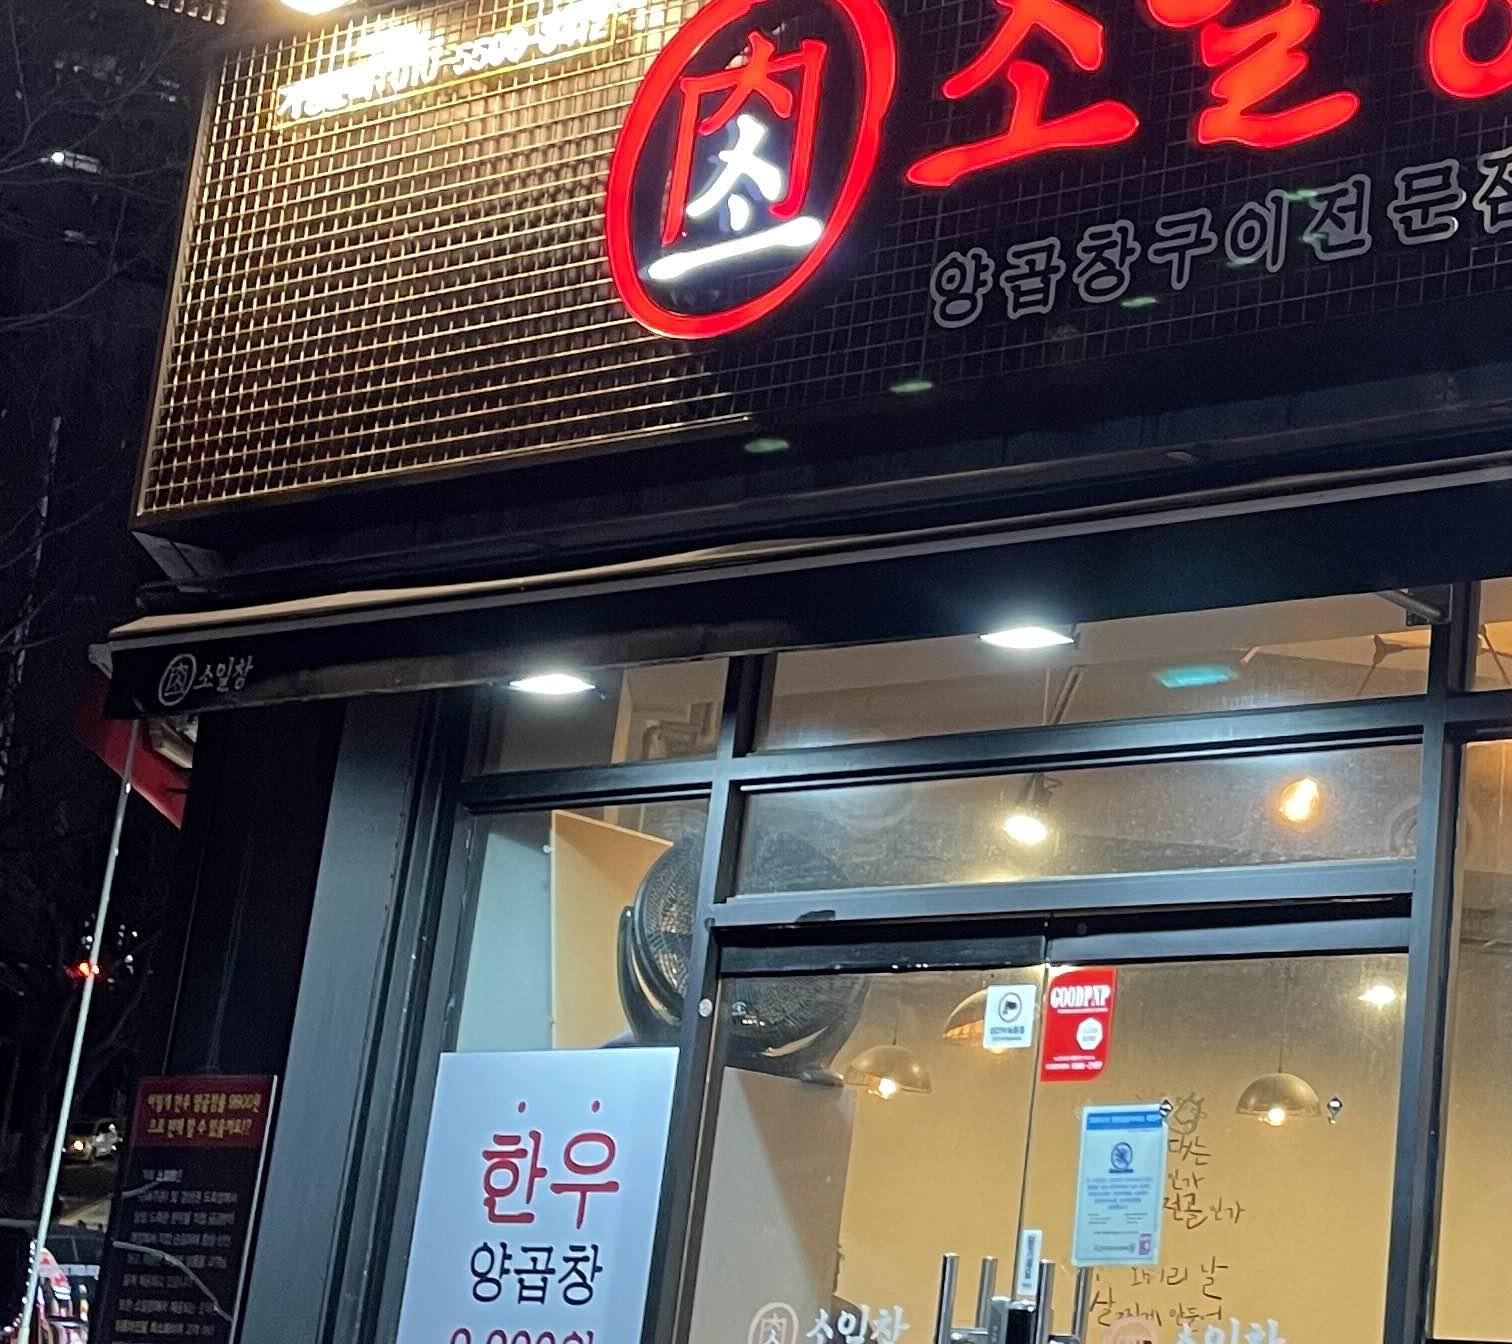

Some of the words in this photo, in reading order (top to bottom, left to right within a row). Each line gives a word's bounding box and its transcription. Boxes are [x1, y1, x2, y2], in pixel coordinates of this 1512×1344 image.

[193, 656, 254, 693] 소일창
[481, 1129, 621, 1229] 한우
[469, 1241, 603, 1306] 양곱창
